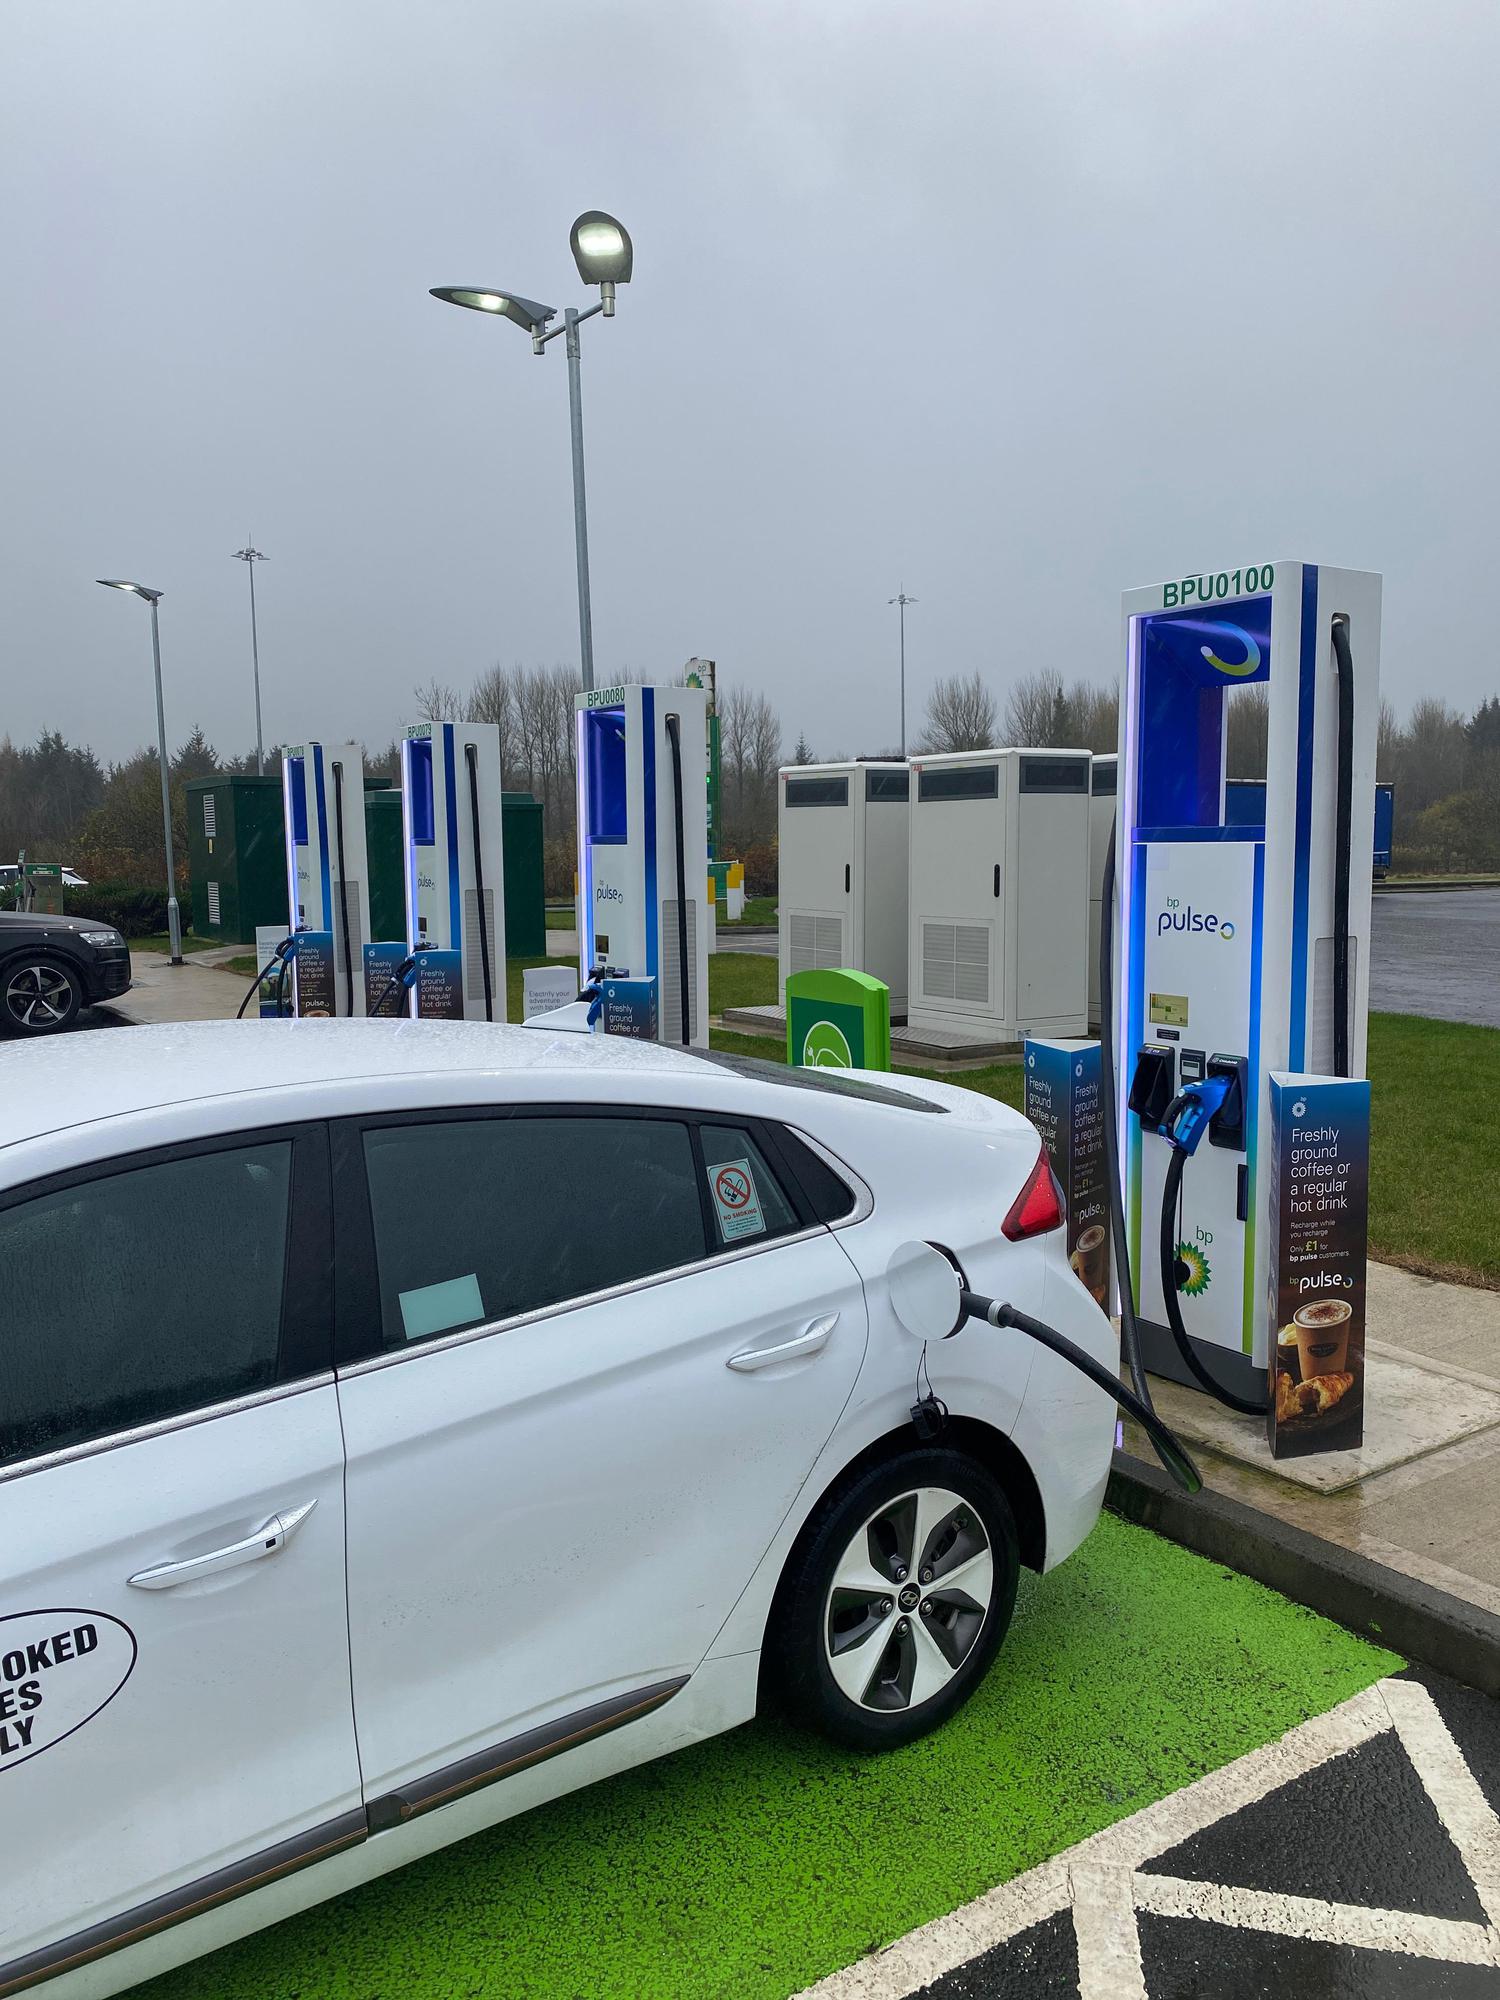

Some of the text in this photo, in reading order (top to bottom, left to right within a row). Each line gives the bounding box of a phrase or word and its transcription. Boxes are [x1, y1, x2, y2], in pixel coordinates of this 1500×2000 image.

[1162, 563, 1275, 608] BPU0100
[587, 687, 625, 708] BPU0080
[913, 764, 923, 772] ABB
[417, 875, 432, 890] pulse
[596, 882, 618, 903] pulse
[1166, 896, 1180, 910] bp
[1158, 905, 1219, 937] pulse
[298, 947, 320, 955] Freshly
[368, 960, 392, 969] Freshly
[369, 968, 392, 976] ground
[420, 969, 446, 978] Freshly
[420, 977, 446, 986] ground
[420, 984, 443, 993] coffee
[427, 993, 451, 1001] regular
[528, 990, 555, 999] Electrify
[305, 999, 325, 1008] pulse
[421, 1000, 434, 1008] hot
[608, 1003, 632, 1013] Freshly
[609, 1014, 632, 1023] ground
[609, 1022, 641, 1032] coffee or
[1029, 1076, 1051, 1095] Freshly
[1075, 1081, 1099, 1099] Freshly
[1029, 1093, 1051, 1108] ground
[1074, 1098, 1098, 1117] ground
[1029, 1107, 1059, 1125] coffee or
[1074, 1110, 1104, 1129] coffee or
[1074, 1125, 1103, 1143] a regular
[1291, 1125, 1340, 1144] Freshly
[1074, 1138, 1103, 1158] hot drink
[1291, 1143, 1338, 1164] ground
[1290, 1161, 1351, 1178] coffee or
[1290, 1178, 1348, 1197] a regular
[1290, 1194, 1348, 1213] hot drink
[733, 1208, 757, 1218] SMOKING
[1078, 1202, 1101, 1225] pulse
[1290, 1219, 1336, 1230] Recharge while
[1195, 1225, 1214, 1246] bp
[1289, 1228, 1329, 1240] you recharge
[1289, 1240, 1329, 1254] Only £1 for
[1289, 1250, 1350, 1263] bp pulse customers
[1289, 1270, 1343, 1294] bp pulse
[0, 1623, 99, 1683] OKED
